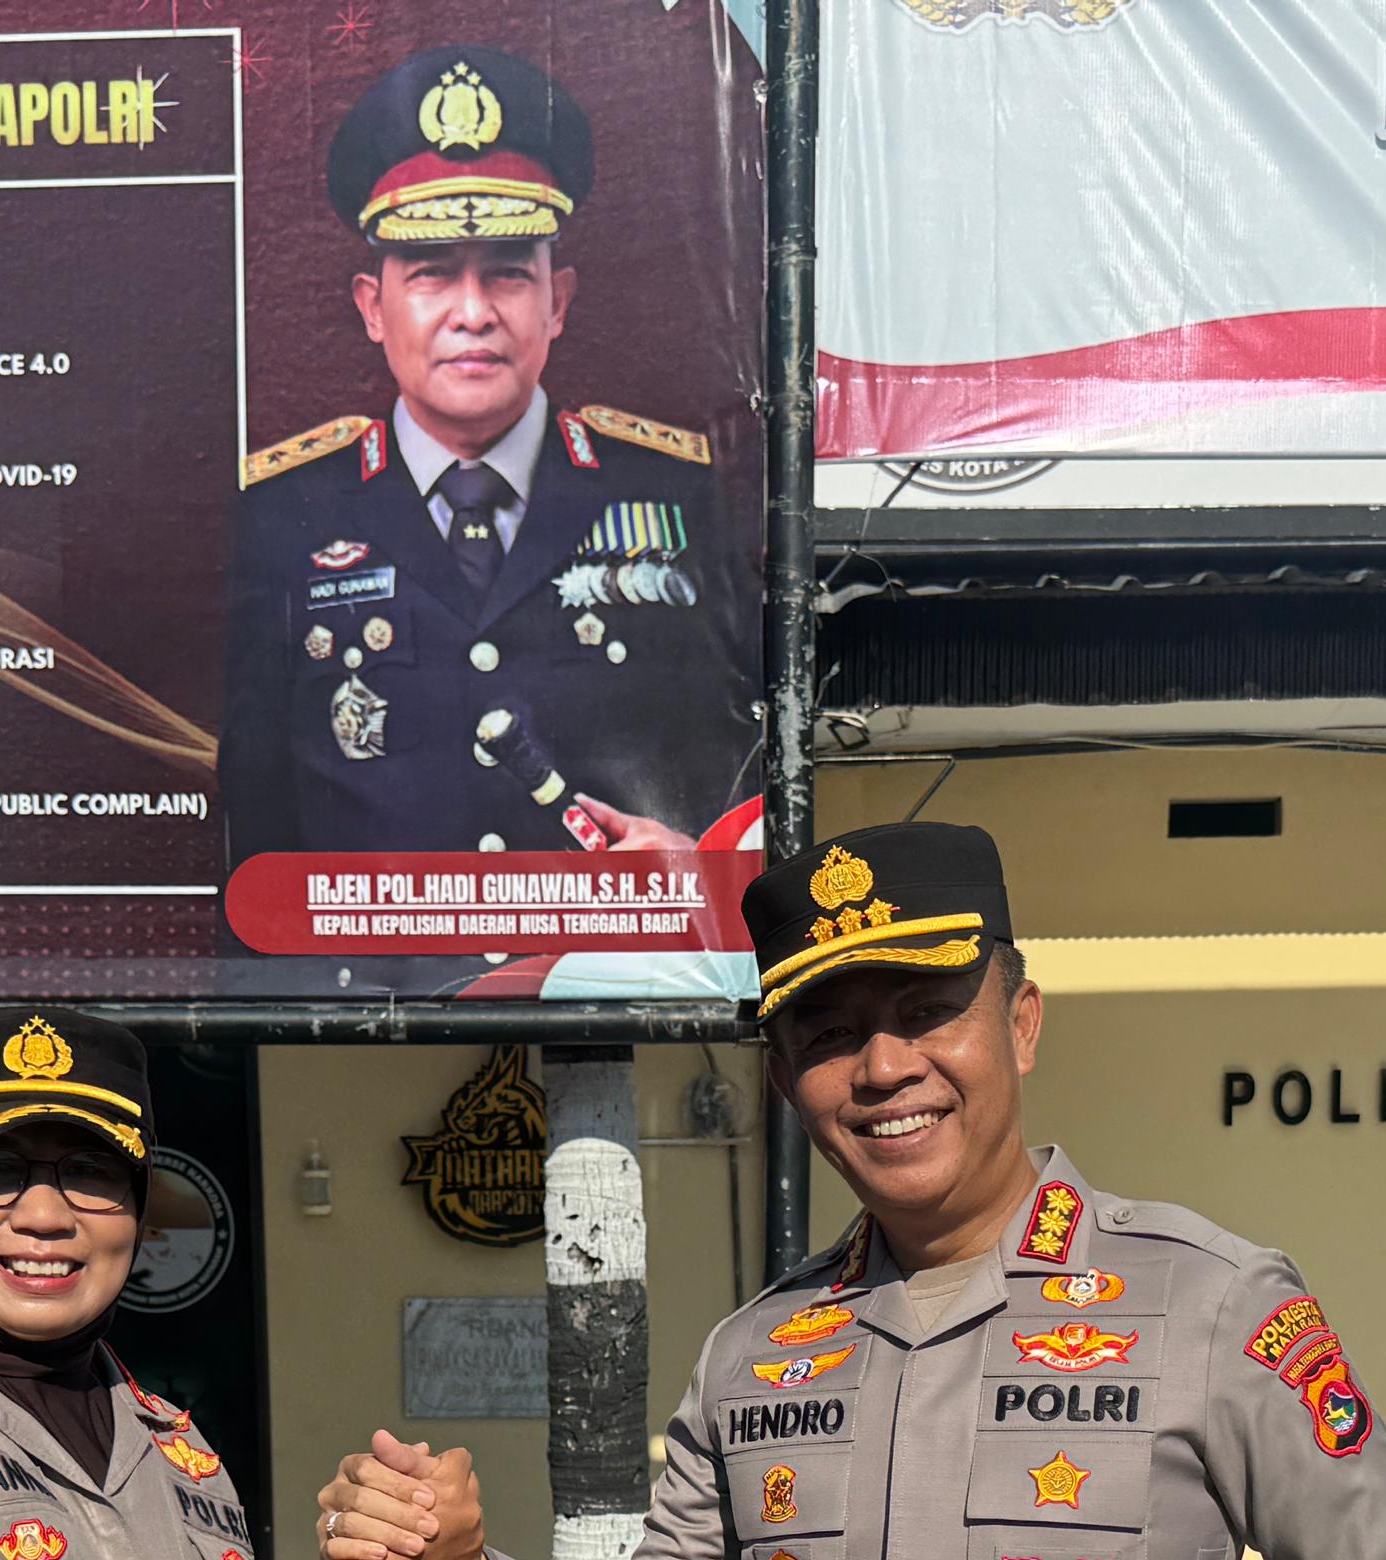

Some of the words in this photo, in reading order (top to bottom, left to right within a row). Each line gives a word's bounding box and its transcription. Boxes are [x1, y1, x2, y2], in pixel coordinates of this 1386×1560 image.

[30, 353, 69, 374] 4.0
[73, 794, 207, 819] COMPLAIN)
[307, 874, 370, 904] IRJEN
[313, 914, 369, 937] KEPALA
[372, 914, 455, 936] KEPOLISIAN
[459, 914, 515, 936] DAERAH
[520, 914, 560, 935] NUSA
[563, 913, 639, 935] TENGGARA
[642, 913, 690, 934] BARAT
[1252, 1300, 1322, 1357] POLRESTA
[729, 1397, 844, 1446] HENDRO
[994, 1384, 1140, 1424] POLRI
[174, 1484, 250, 1545] POLRI
